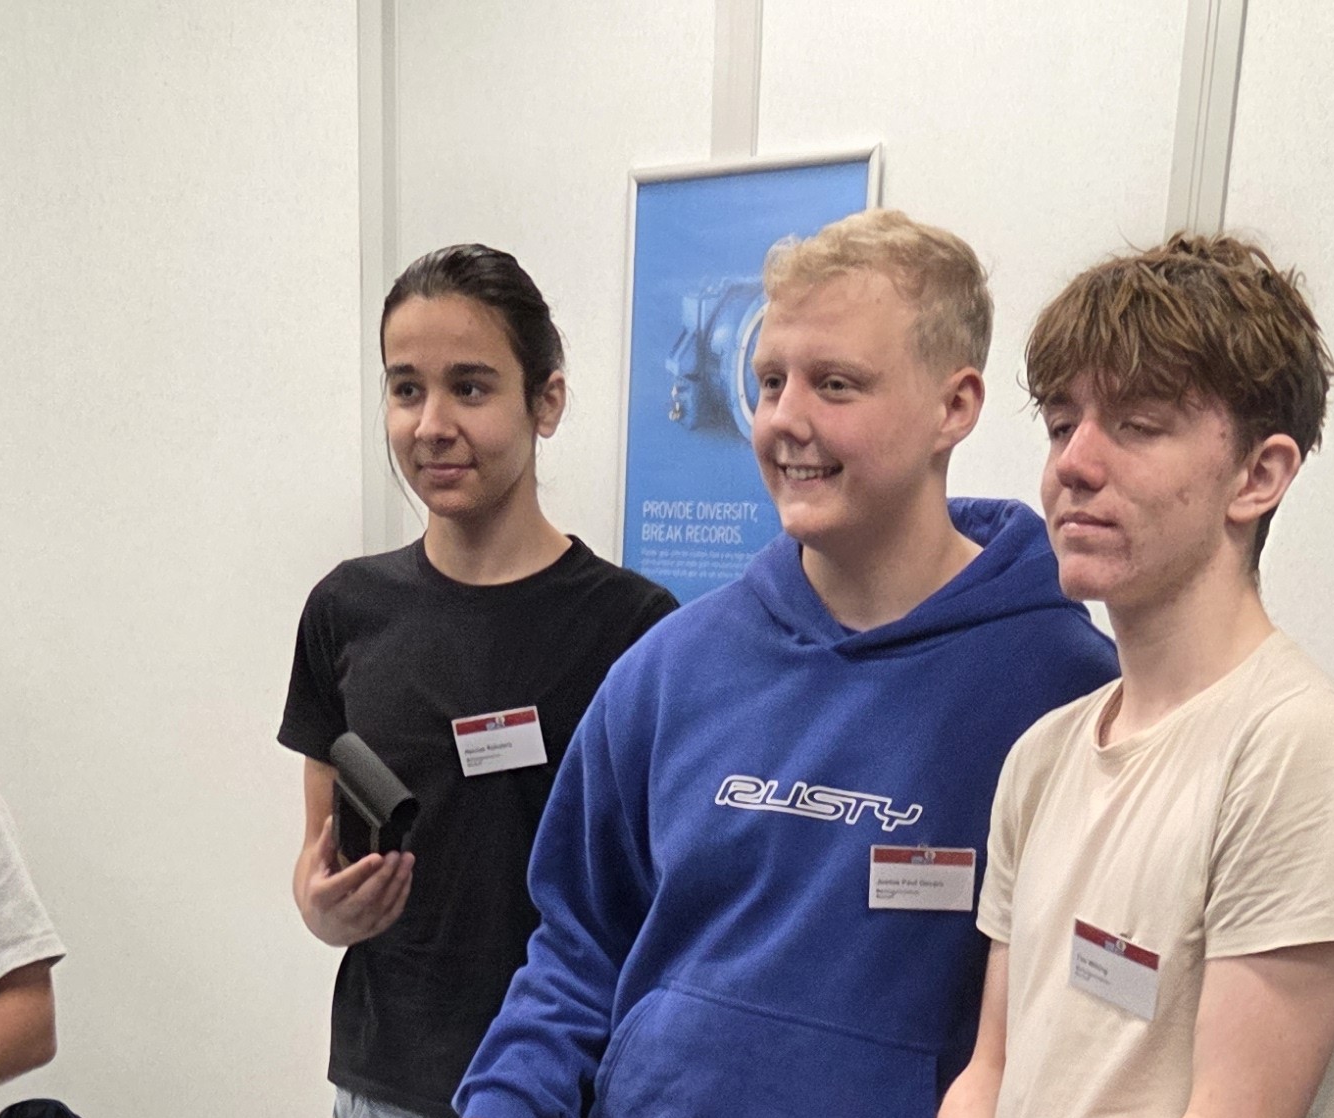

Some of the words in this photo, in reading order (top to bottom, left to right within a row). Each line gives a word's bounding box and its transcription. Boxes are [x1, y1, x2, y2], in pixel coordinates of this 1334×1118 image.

[642, 501, 693, 519] PROVIDE
[697, 502, 758, 523] DIVERSITY,
[641, 523, 683, 542] BREAK
[685, 524, 744, 544] RECORDS.
[715, 774, 923, 832] RUSTY
